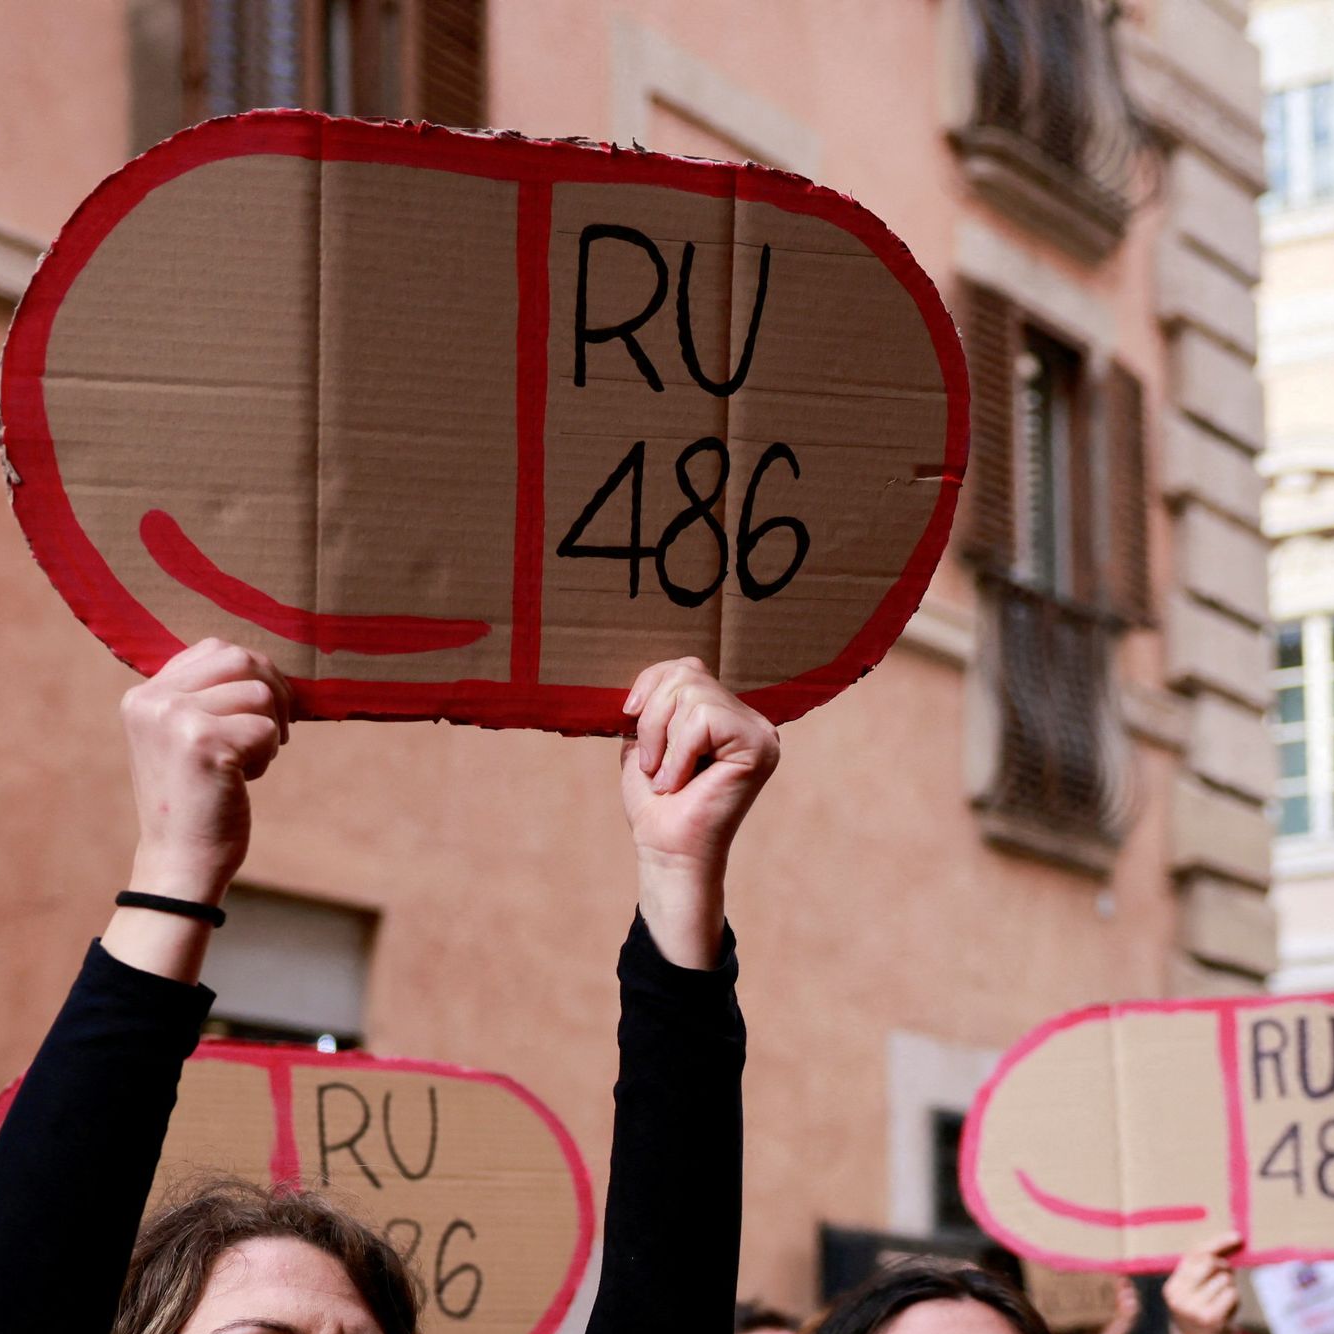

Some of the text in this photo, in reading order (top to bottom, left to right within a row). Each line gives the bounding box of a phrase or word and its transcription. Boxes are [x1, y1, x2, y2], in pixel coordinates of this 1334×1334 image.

[574, 223, 771, 398] RU
[555, 436, 811, 609] 486
[316, 1082, 439, 1190] RU
